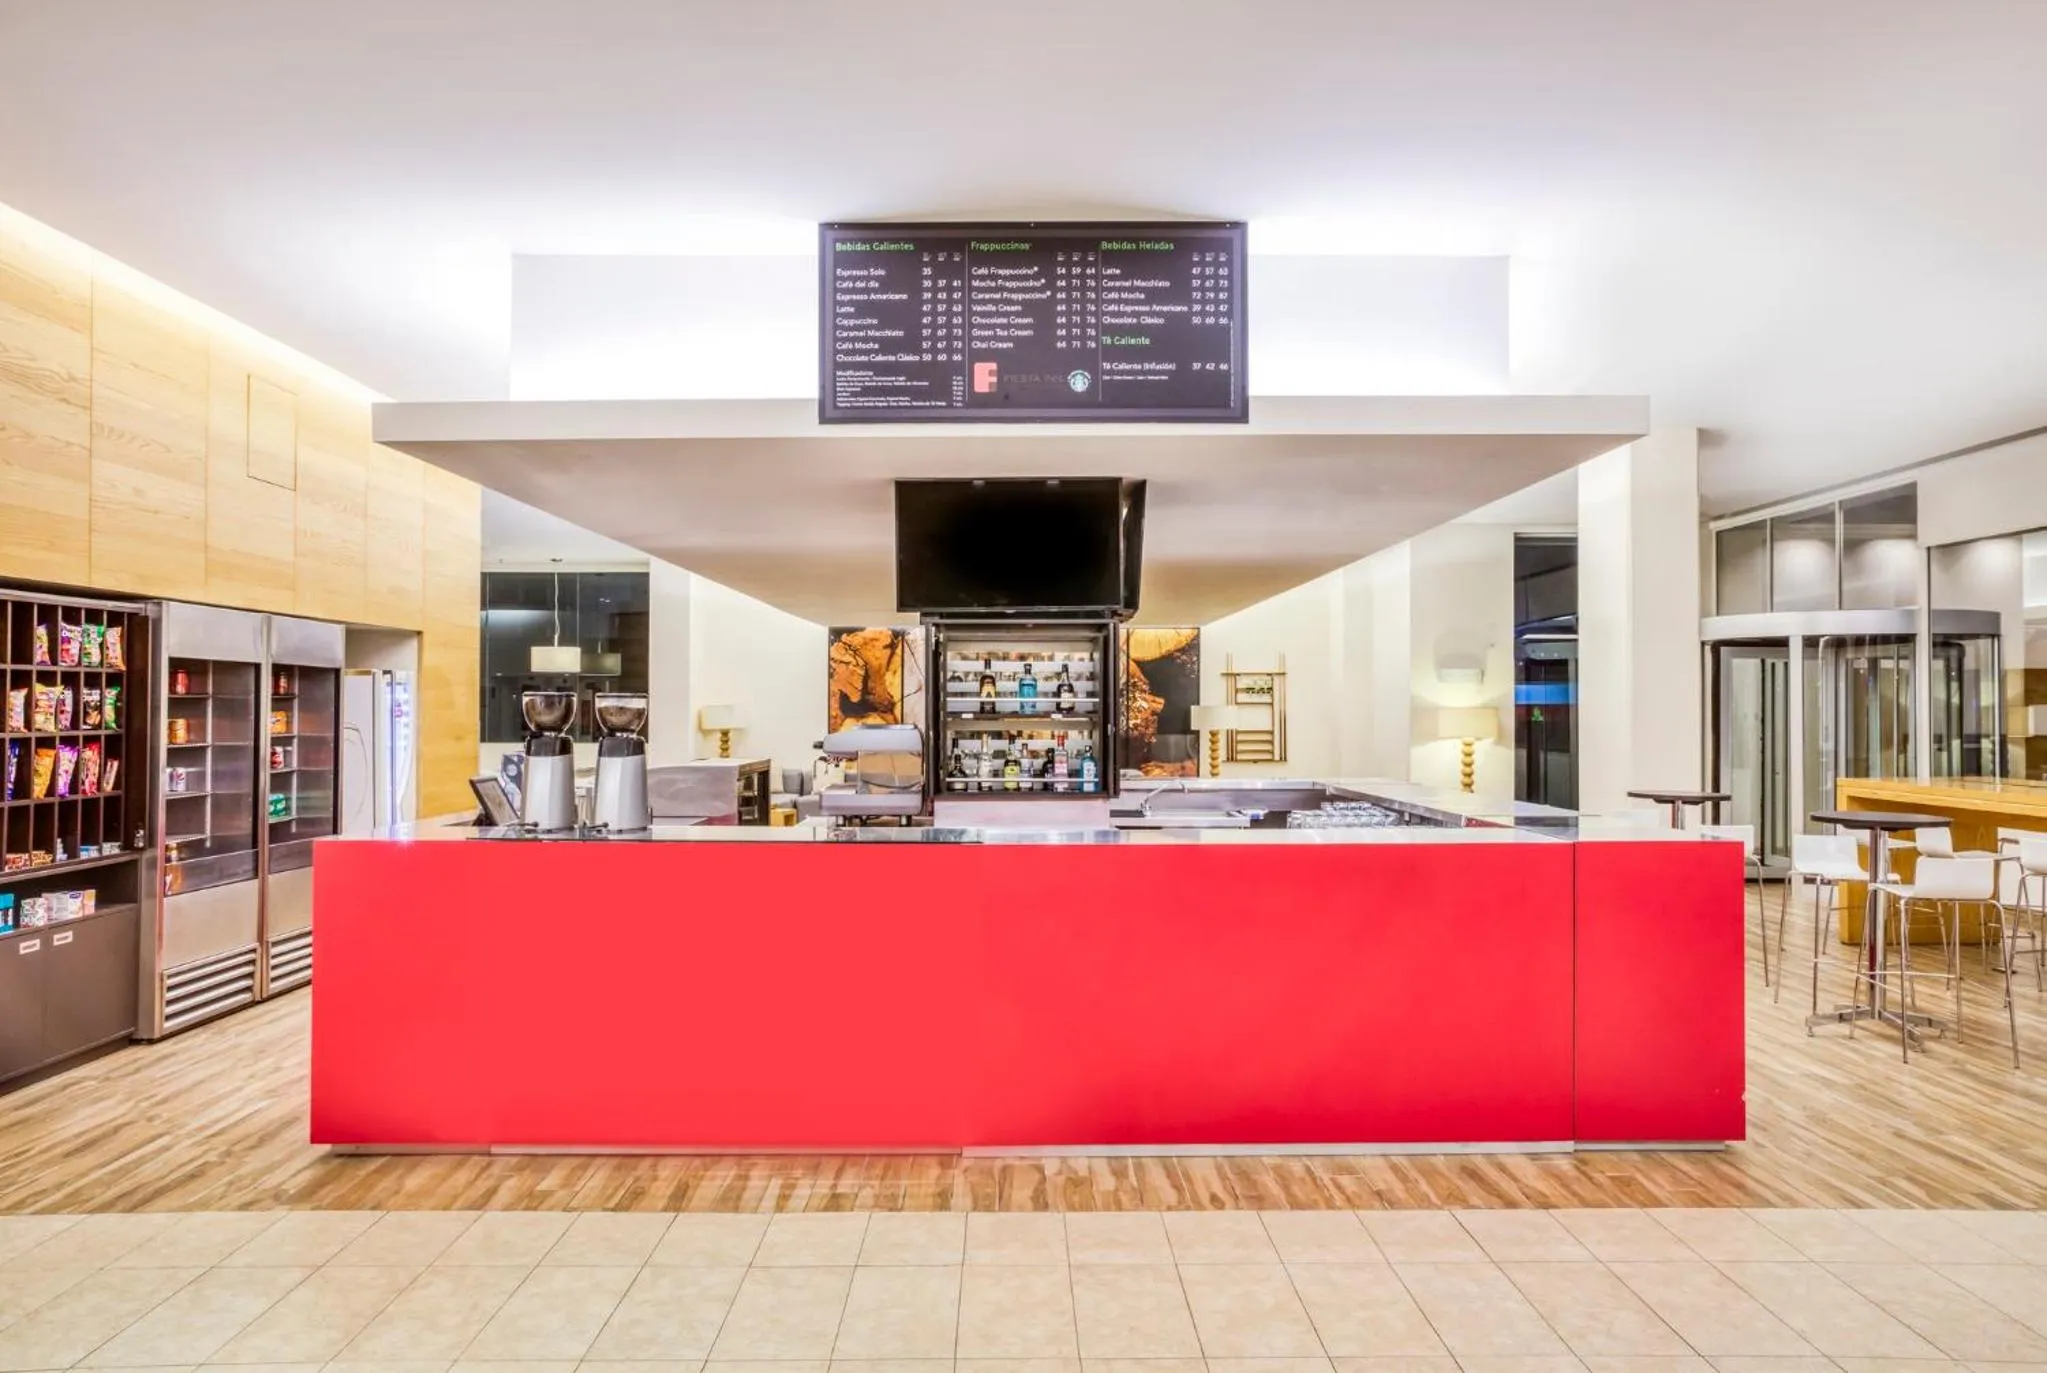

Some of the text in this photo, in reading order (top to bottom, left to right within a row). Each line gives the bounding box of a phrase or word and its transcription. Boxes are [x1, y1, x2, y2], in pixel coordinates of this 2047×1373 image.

[836, 242, 915, 251] Bebidas Calientes
[1101, 241, 1174, 250] Bebidas Heladas
[972, 267, 989, 275] Café
[1102, 267, 1121, 275] Latte
[869, 292, 908, 300] Americano
[971, 291, 1001, 299] Caramel
[1071, 291, 1081, 299] 71
[836, 305, 855, 313] Latte
[922, 304, 932, 312] 47
[937, 304, 947, 312] 57
[922, 316, 932, 324] 47
[937, 316, 947, 324] 57
[972, 316, 1008, 324] Chocolate
[1009, 316, 1034, 324] Cream
[1071, 316, 1081, 324] 71
[1102, 316, 1137, 324] Chocolate
[1114, 336, 1150, 345] Caliente
[922, 341, 932, 349] 57
[952, 341, 962, 349] 73
[1071, 341, 1081, 349] 71
